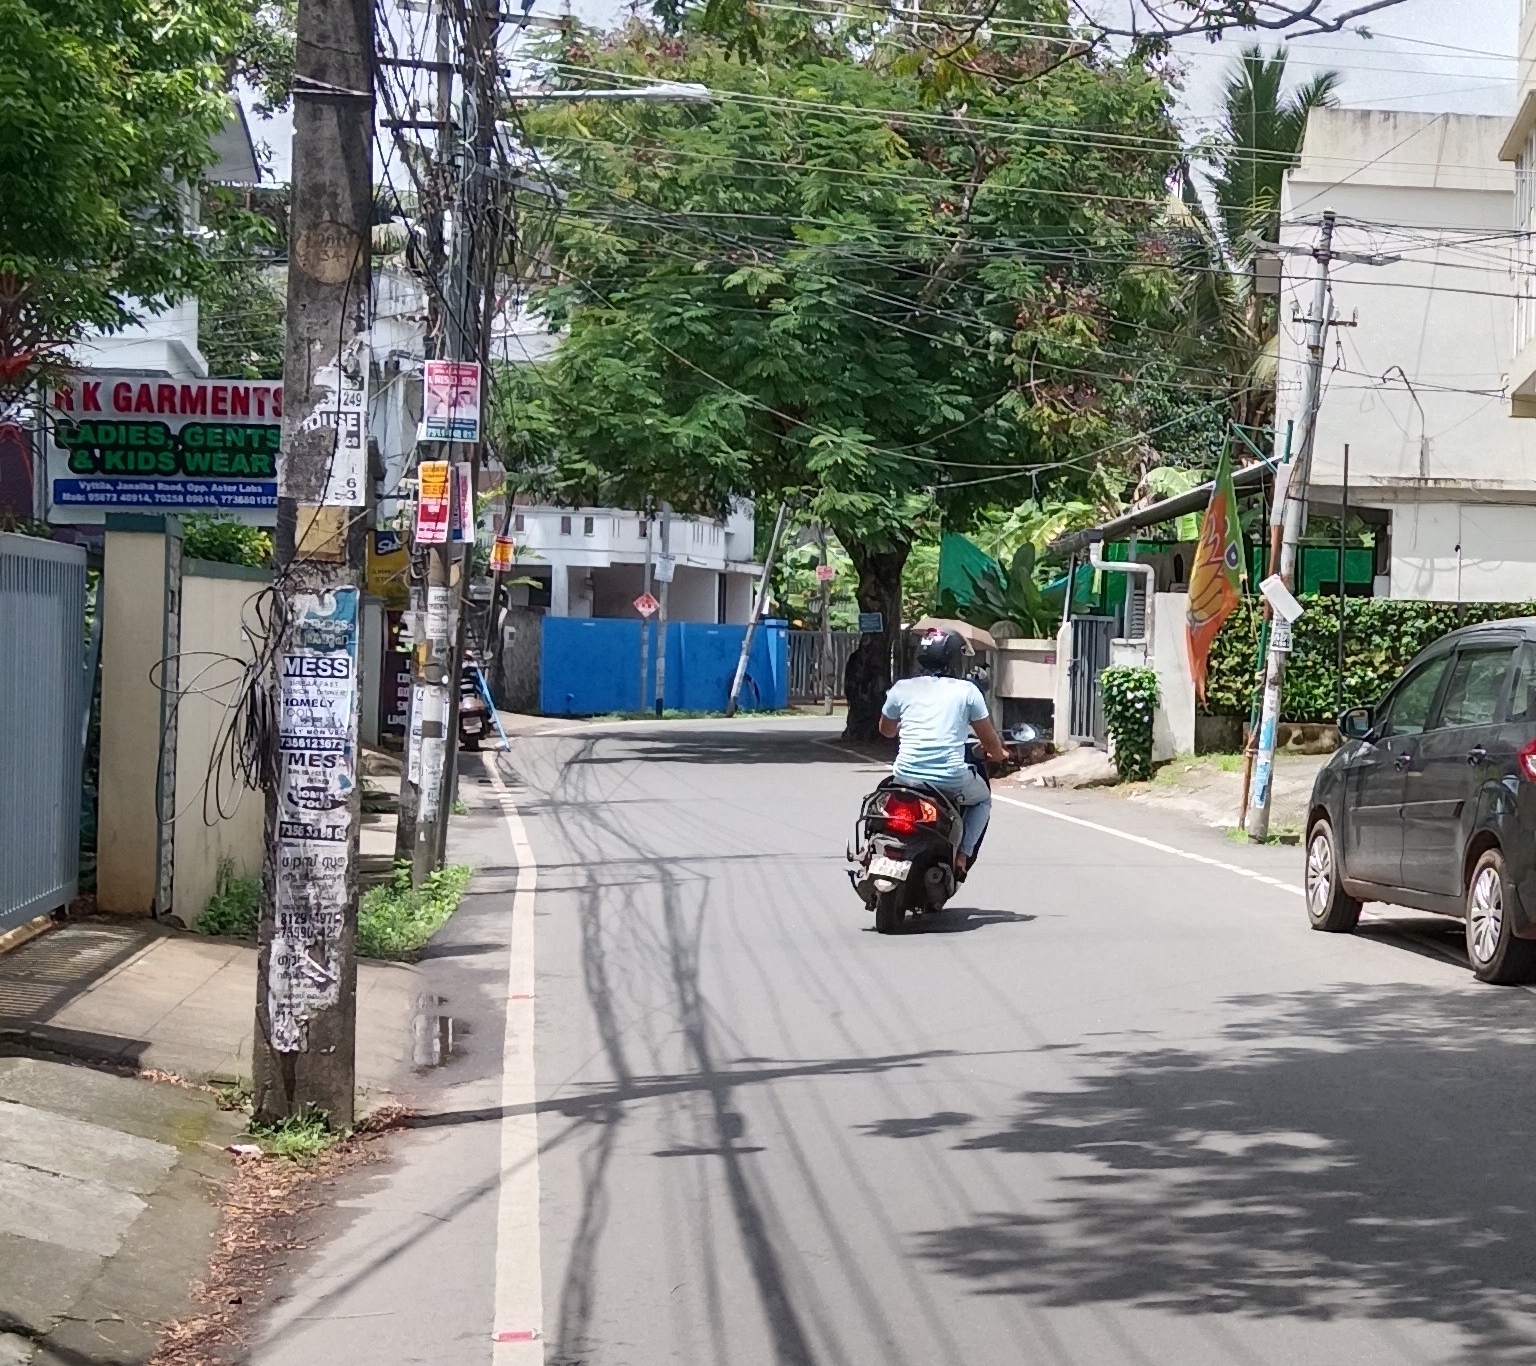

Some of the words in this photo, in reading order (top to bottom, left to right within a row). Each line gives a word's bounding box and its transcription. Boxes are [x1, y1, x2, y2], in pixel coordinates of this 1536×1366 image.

[113, 381, 283, 417] GARMENTS
[63, 424, 174, 448] LADIES,
[184, 426, 280, 448] GENTS
[73, 449, 94, 470] &
[104, 450, 176, 471] KIDS
[184, 452, 272, 473] WEAR
[283, 657, 349, 677] MESS
